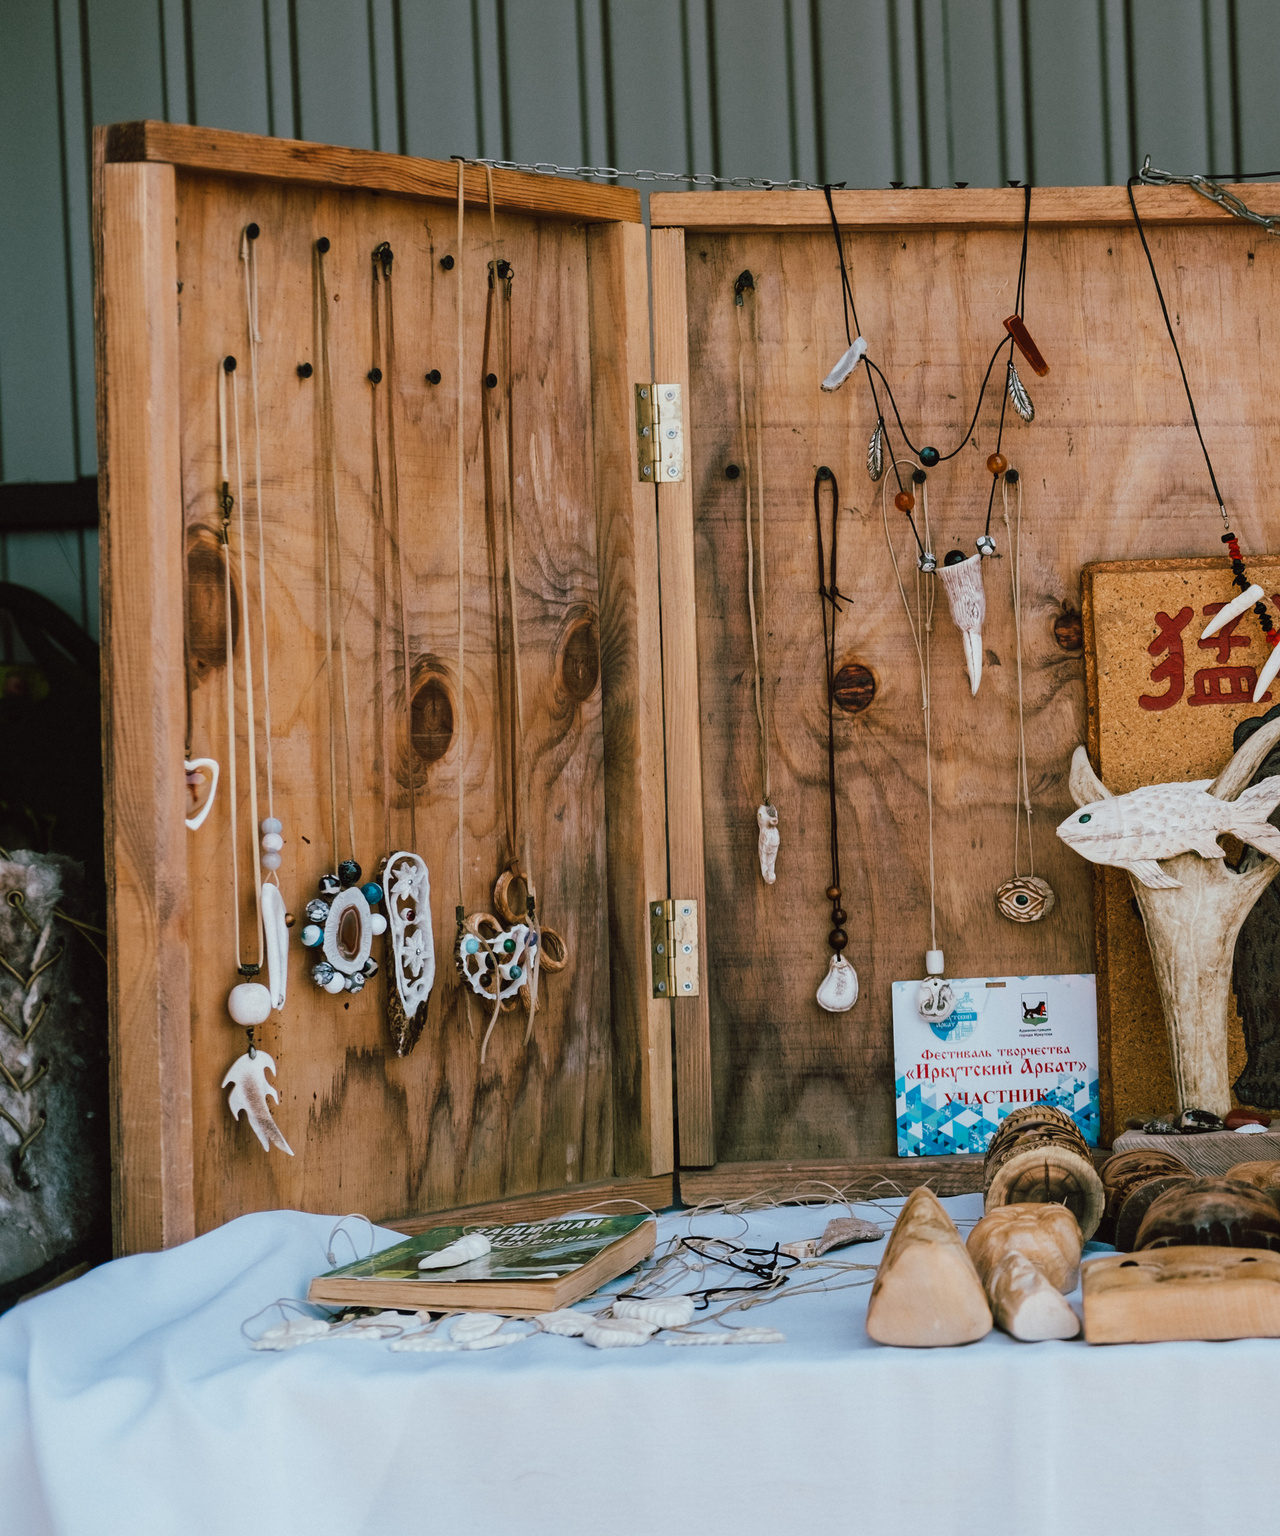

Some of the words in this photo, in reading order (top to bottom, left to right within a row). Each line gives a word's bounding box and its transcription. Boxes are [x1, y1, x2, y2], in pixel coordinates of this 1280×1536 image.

[921, 1049, 992, 1061] Фестиваль
[996, 1046, 1071, 1059] творчества
[905, 1060, 1013, 1083] «Иркутский
[1020, 1058, 1087, 1078] Арбат»
[944, 1087, 1049, 1106] УЧАСТНИК
[485, 1232, 543, 1242] АГИЯ
